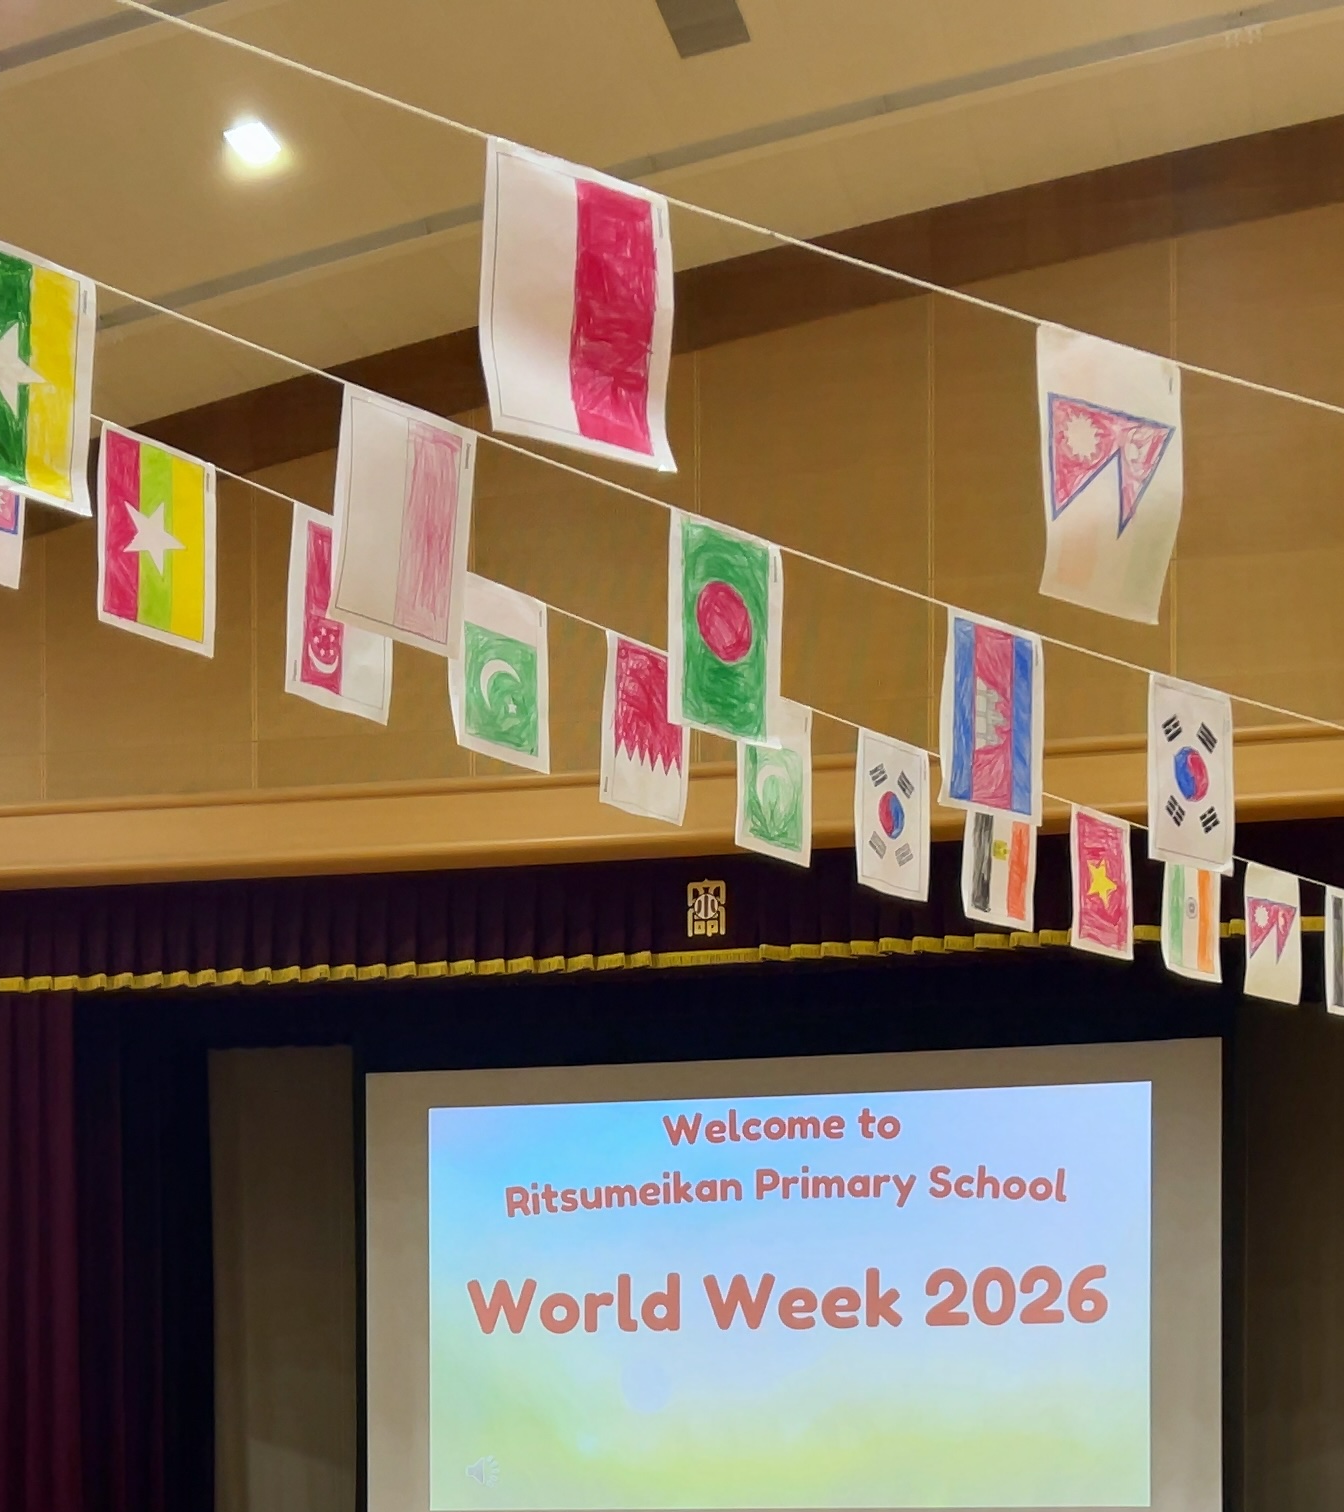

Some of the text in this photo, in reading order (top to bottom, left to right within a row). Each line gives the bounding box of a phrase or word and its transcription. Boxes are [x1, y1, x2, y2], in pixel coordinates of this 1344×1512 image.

[663, 1108, 902, 1145] Welcome to
[505, 1165, 1068, 1217] Ritsumeikan Primary School
[467, 1264, 1109, 1335] World Week 2026
